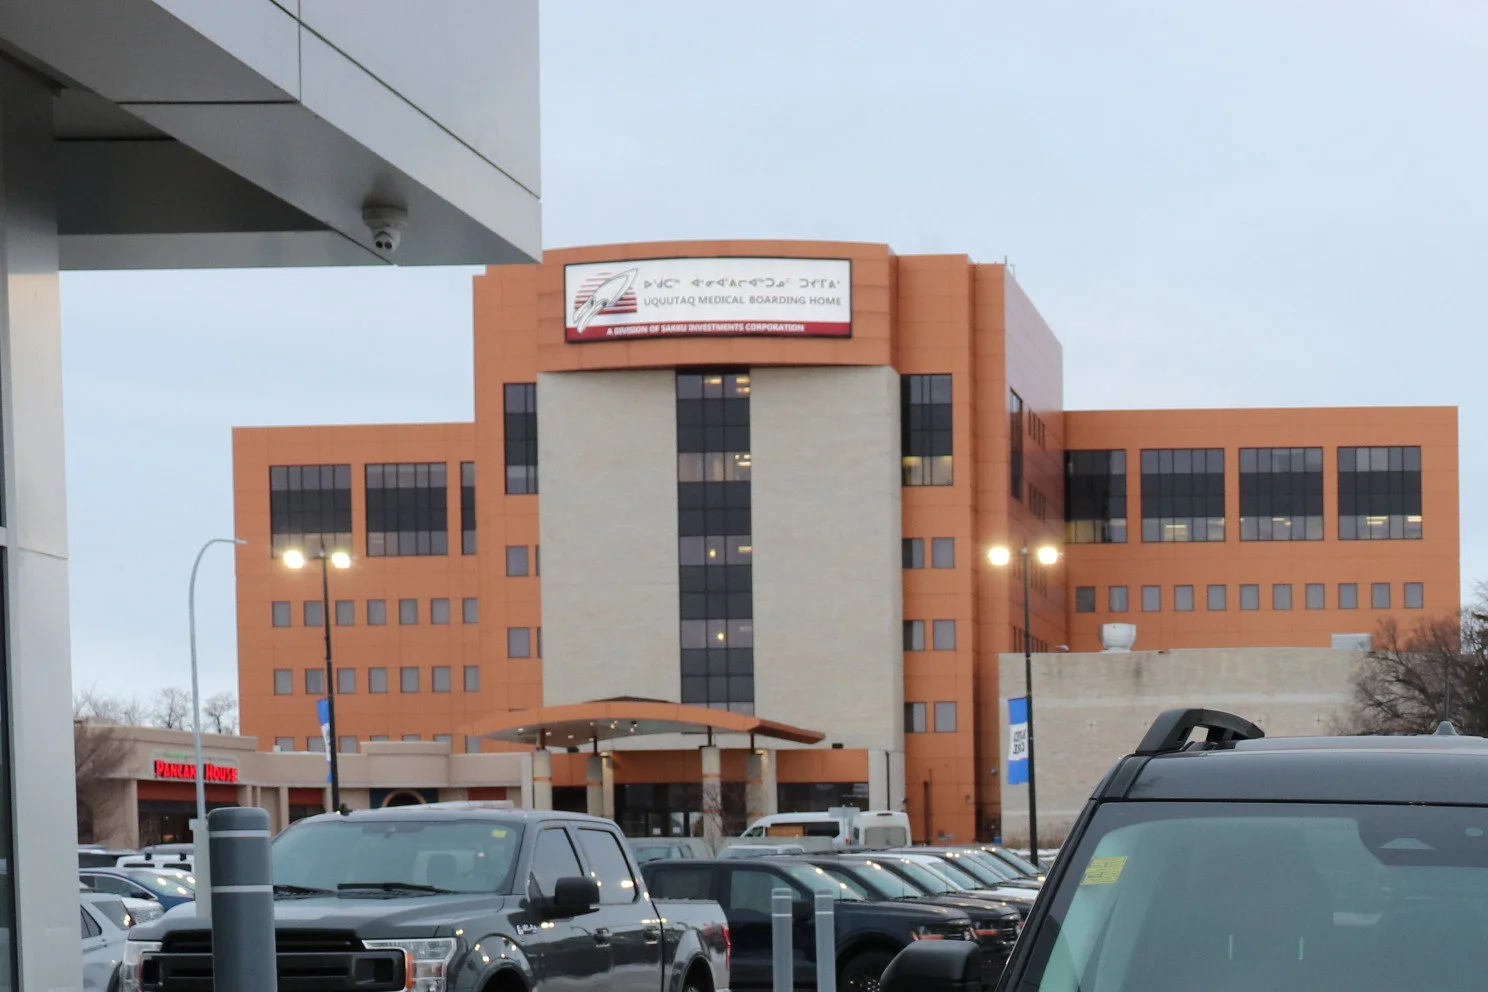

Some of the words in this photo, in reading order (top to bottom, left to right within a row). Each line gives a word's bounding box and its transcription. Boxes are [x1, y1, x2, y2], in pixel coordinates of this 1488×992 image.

[644, 296, 695, 307] UQUUTAQ
[698, 295, 745, 305] MEDICAL
[749, 295, 806, 305] BOARDING
[809, 296, 842, 306] HOME
[614, 326, 648, 336] DIVISION
[649, 325, 660, 334] OF
[688, 323, 744, 333] INVESTMENTS
[745, 323, 805, 332] CORPORATION
